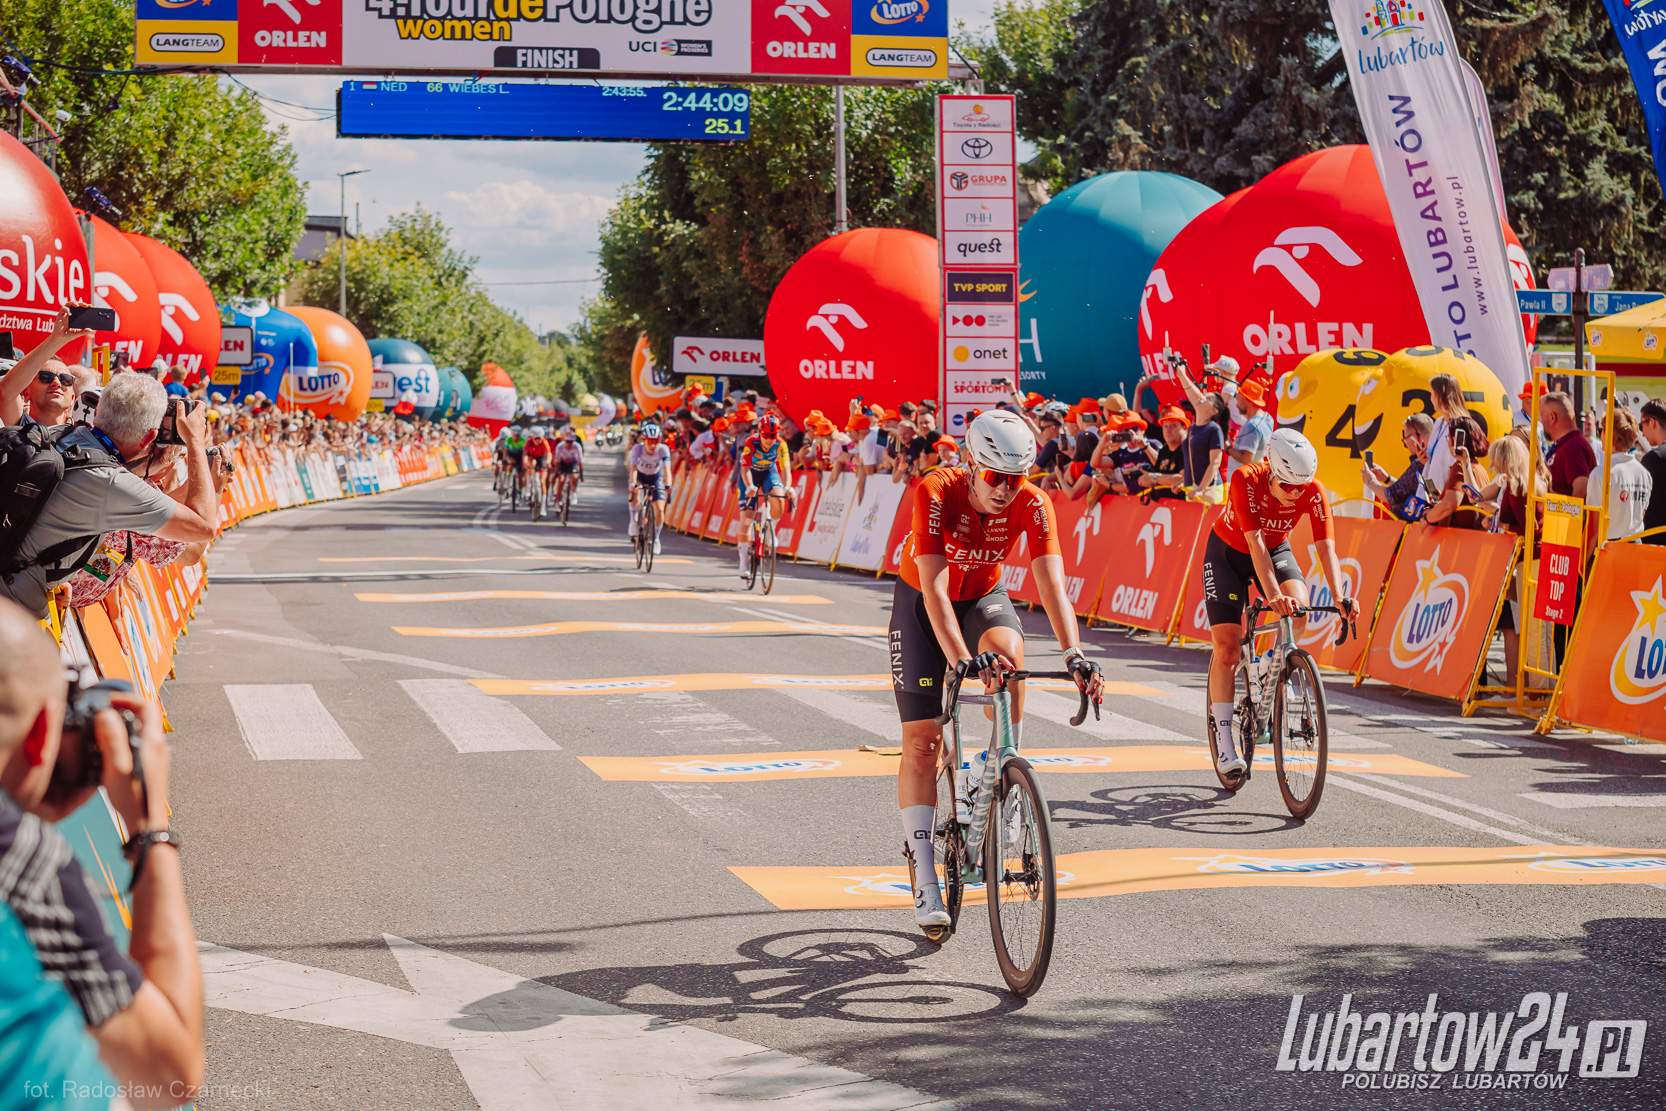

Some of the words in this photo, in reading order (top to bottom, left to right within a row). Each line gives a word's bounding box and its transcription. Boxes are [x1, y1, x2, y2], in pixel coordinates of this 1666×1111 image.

[882, 1, 918, 18] LOTTO
[254, 30, 327, 48] ORLEN
[395, 17, 512, 41] women
[628, 41, 657, 53] UCI
[766, 40, 836, 59] ORLEN
[516, 49, 579, 68] FINISH
[381, 82, 407, 92] NED
[427, 82, 443, 92] 66
[448, 83, 496, 94] WIEBES
[662, 91, 749, 112] 2:44:09
[704, 118, 745, 134] 25.1
[970, 175, 1007, 184] GRUPA
[957, 237, 1002, 257] quest
[1447, 176, 1488, 315] www.lubartow.pl
[953, 283, 974, 293] TVP
[976, 283, 1008, 293] SPORT
[1242, 322, 1374, 356] ORLEN
[709, 350, 761, 364] ORLEN
[973, 348, 1008, 360] onet
[799, 359, 875, 380] ORLEN
[298, 372, 340, 393] LOTTO
[928, 494, 944, 536] FENIX
[1549, 553, 1570, 576] CLUB
[1203, 562, 1218, 600] FENIX
[1549, 580, 1564, 601] TDP
[1111, 584, 1159, 619] ORLEN
[1406, 598, 1454, 644] LOTTO
[1545, 605, 1559, 619] Stage
[890, 630, 905, 690] FENIX
[1239, 858, 1369, 874] LOTTO
